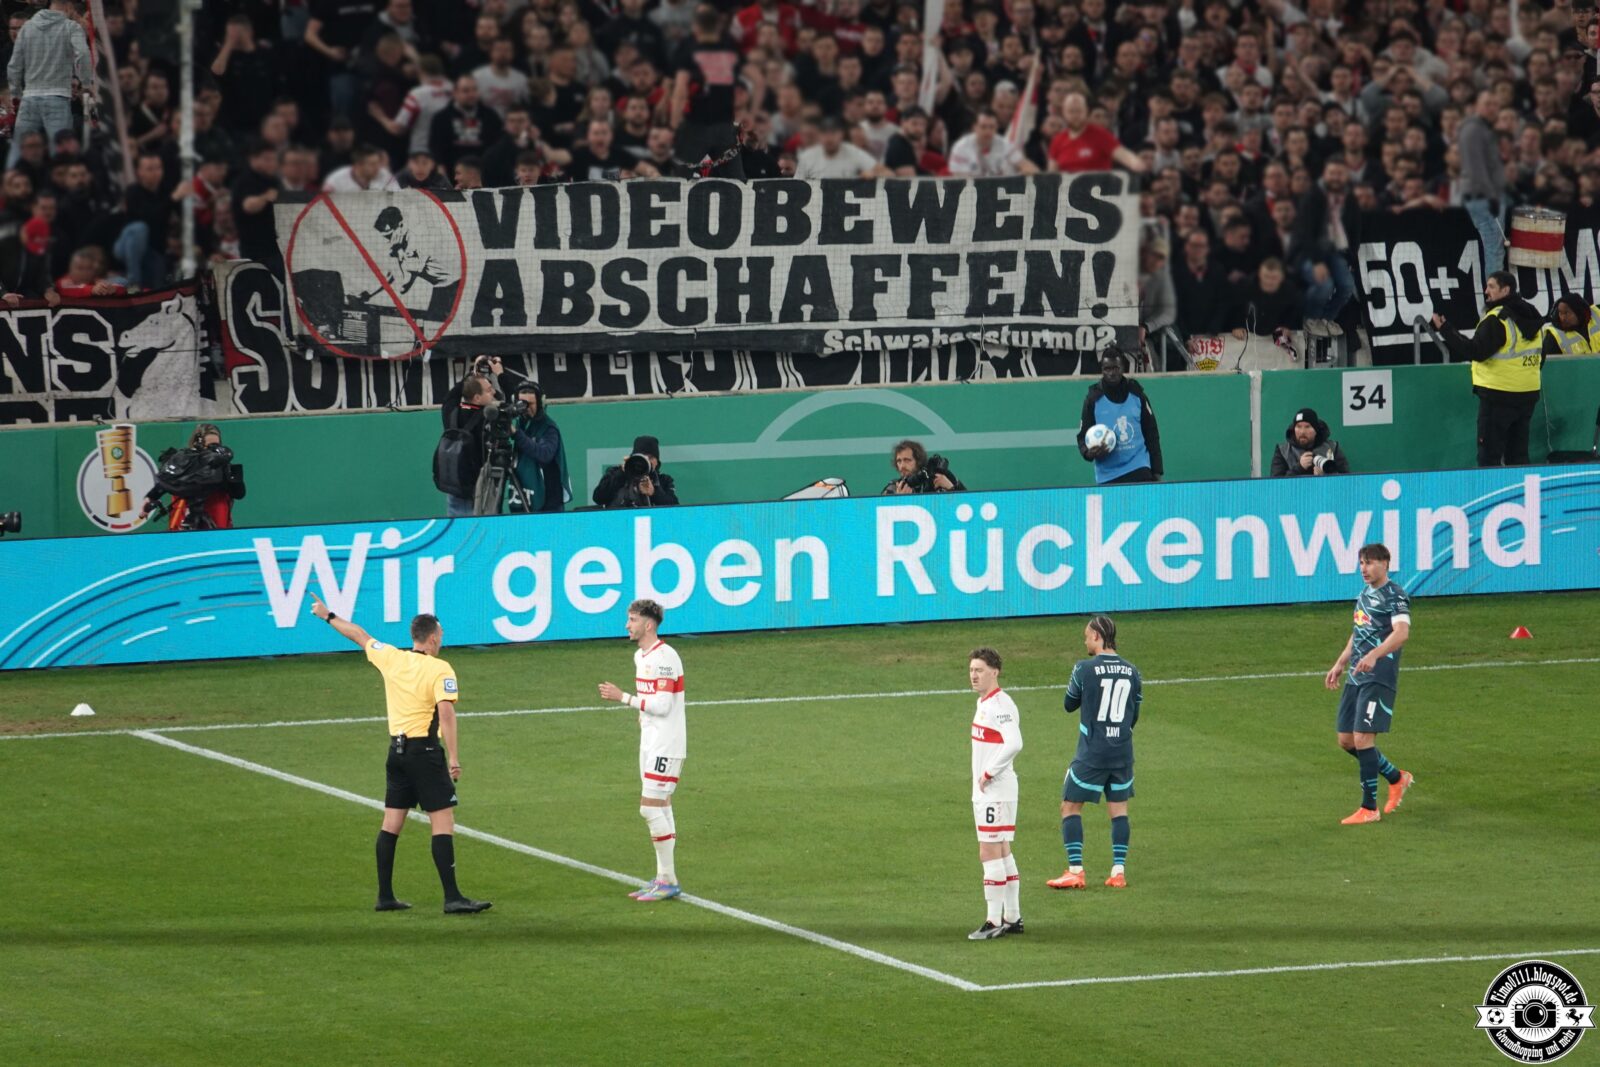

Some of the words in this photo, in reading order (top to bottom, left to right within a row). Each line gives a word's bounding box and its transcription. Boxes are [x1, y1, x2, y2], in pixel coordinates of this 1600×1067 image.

[471, 173, 1123, 250] VIDEOBEWEIS
[470, 250, 1116, 328] ABSCHAFFEN!
[1358, 240, 1486, 328] 50+1
[1350, 384, 1387, 411] 34
[252, 527, 455, 628] Wir
[492, 515, 830, 642] geben
[876, 474, 1541, 597] Rückenwind
[1095, 666, 1106, 676] RB
[1107, 665, 1133, 676] LEIPZIG
[1097, 679, 1132, 722] 10
[1106, 726, 1120, 737] XAVI
[654, 756, 668, 773] 16
[986, 806, 995, 823] 6
